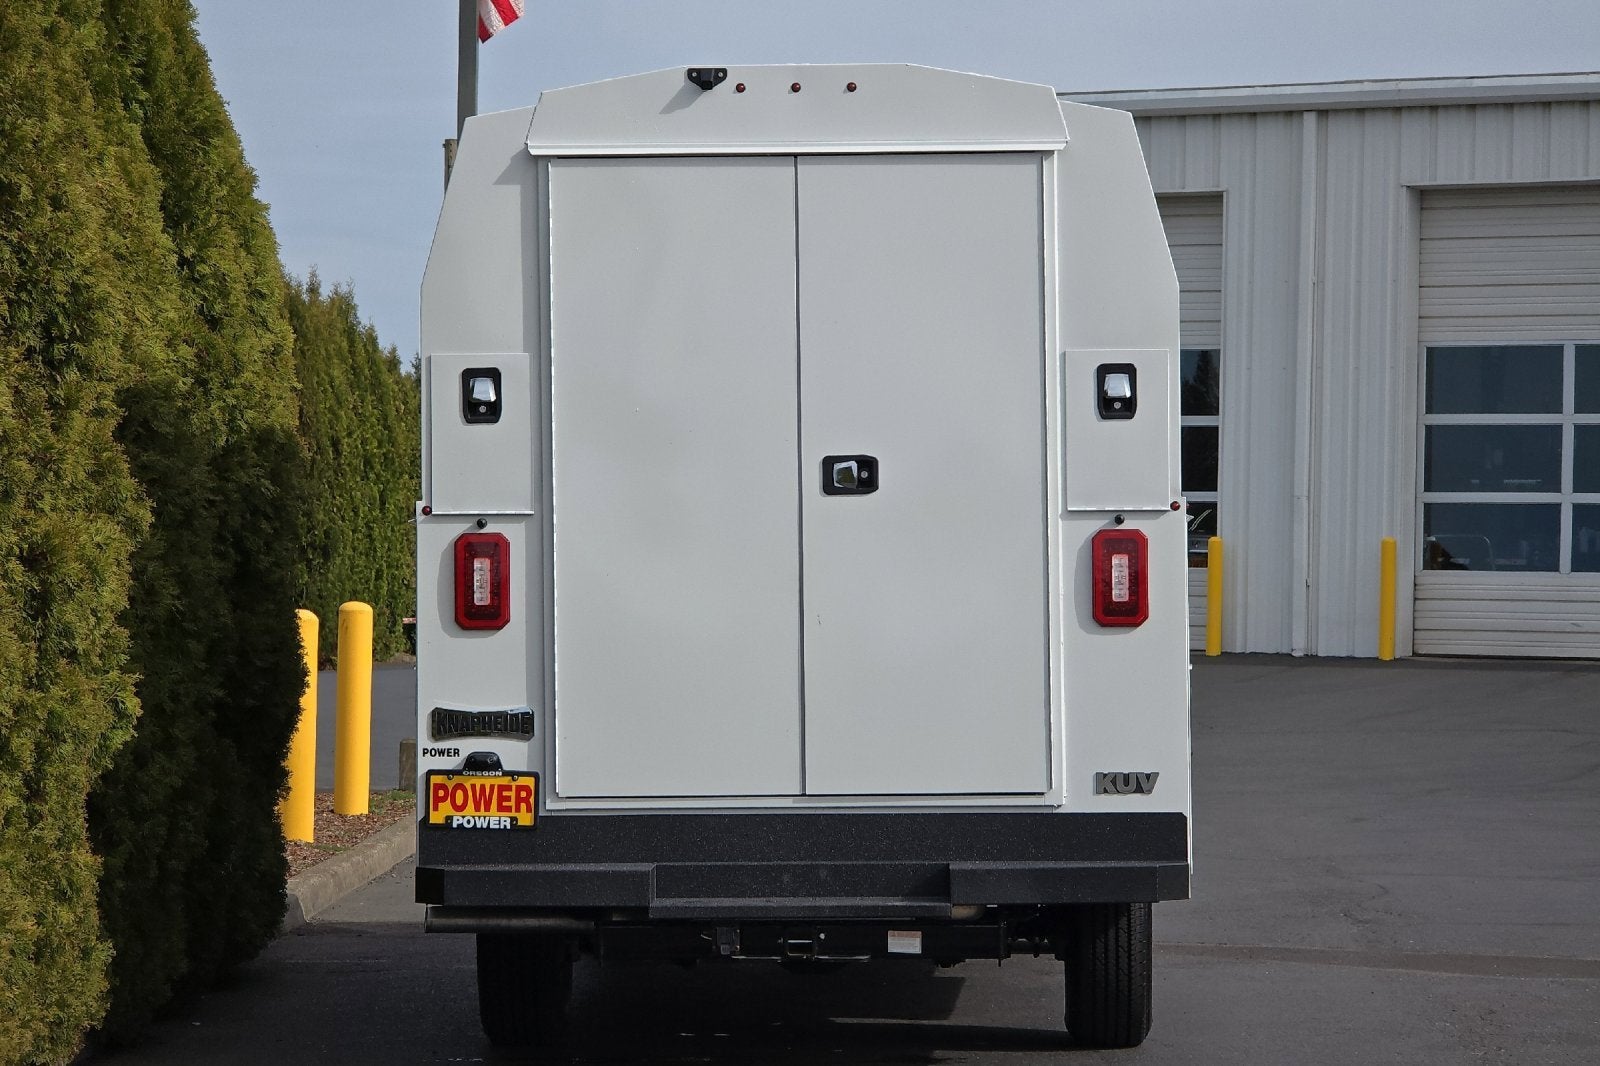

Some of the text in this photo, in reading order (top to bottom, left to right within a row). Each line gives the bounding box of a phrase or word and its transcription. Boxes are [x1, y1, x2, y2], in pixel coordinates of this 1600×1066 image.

[422, 747, 460, 758] POWER
[1096, 772, 1159, 794] KUV
[431, 782, 533, 814] POWER
[452, 815, 511, 830] POWER
